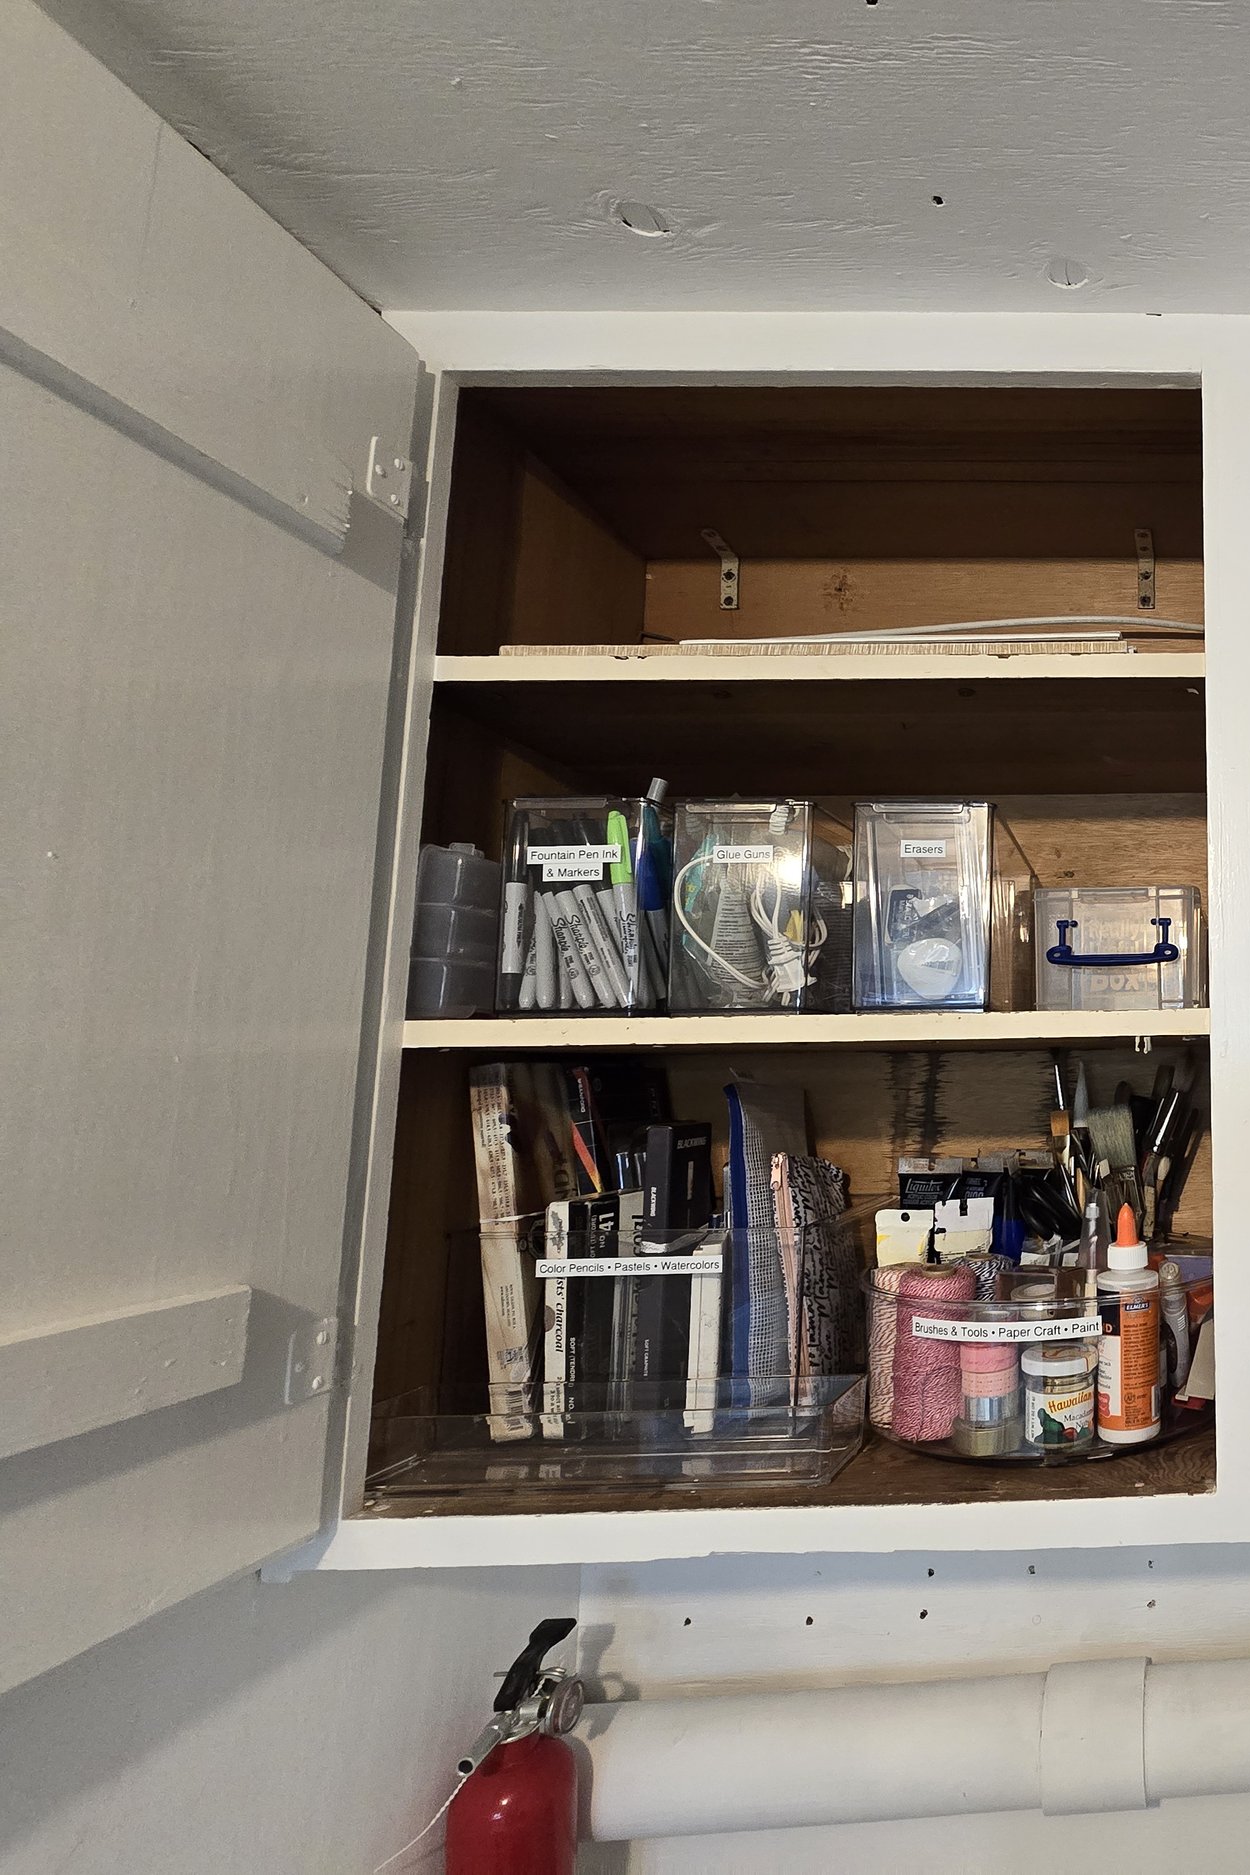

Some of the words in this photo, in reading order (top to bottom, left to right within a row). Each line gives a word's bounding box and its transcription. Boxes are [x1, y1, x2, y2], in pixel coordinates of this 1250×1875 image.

[530, 850, 576, 861] Fountain
[578, 849, 599, 859] Pen
[602, 849, 619, 859] Ink
[716, 850, 741, 860] Glue
[744, 849, 771, 859] Guns
[904, 844, 943, 854] Erasers
[546, 868, 554, 878] &
[557, 867, 600, 877] Markers
[539, 1264, 566, 1274] Color
[569, 1262, 604, 1273] Pencils
[614, 1261, 650, 1272] Pastels
[661, 1260, 720, 1271] Watercolors
[555, 1302, 565, 1353] charcoal
[915, 1322, 948, 1336] Brushes
[951, 1326, 958, 1336] &
[961, 1327, 988, 1338] Tools
[999, 1327, 1030, 1339] Paper
[1034, 1325, 1061, 1336] Craft
[1071, 1321, 1099, 1333] Paint
[1048, 1391, 1092, 1413] Hawaiian
